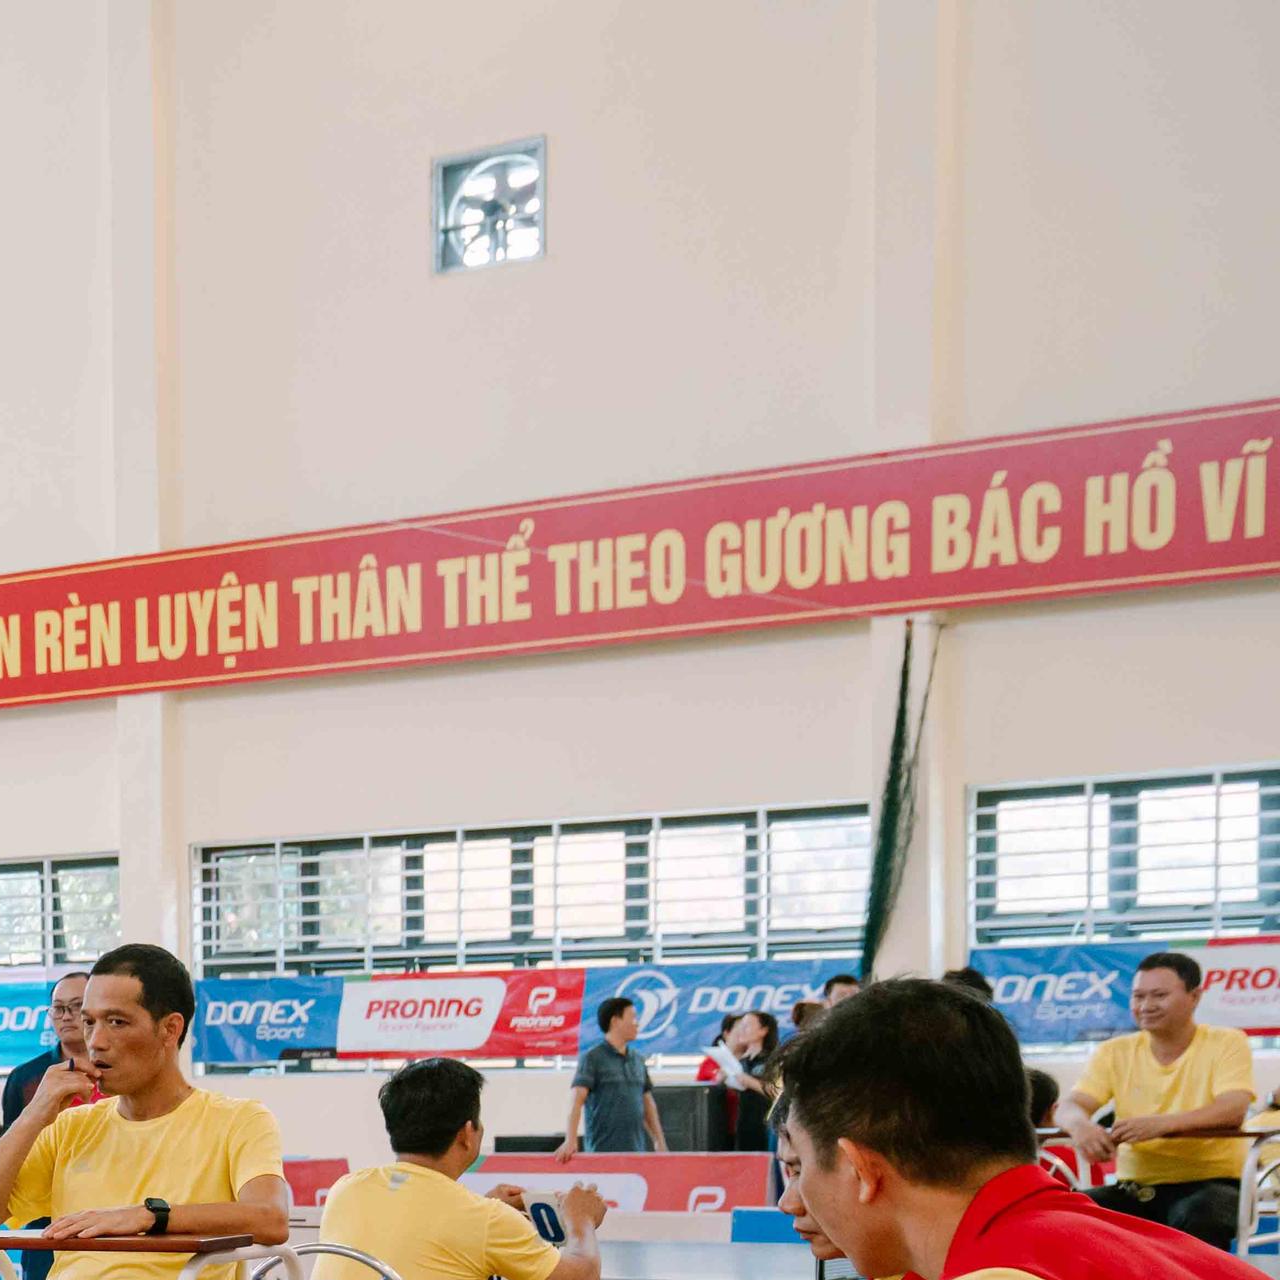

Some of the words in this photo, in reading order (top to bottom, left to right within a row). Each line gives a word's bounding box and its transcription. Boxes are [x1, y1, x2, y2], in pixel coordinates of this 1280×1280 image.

[34, 593, 121, 675] RÈN
[134, 571, 279, 669] LUYỆN
[292, 553, 422, 645] THÂN
[436, 518, 533, 629] THỂ
[547, 528, 687, 616] THEO
[704, 500, 911, 599] GƯƠNG
[931, 470, 1063, 574] BÁC
[1083, 438, 1177, 557] HỒ
[1199, 436, 1274, 543] VĨ
[986, 969, 1120, 1005] ONEX
[205, 998, 316, 1026] DONEX
[365, 996, 485, 1020] PRONING
[1036, 1001, 1107, 1021] Sport
[255, 1024, 306, 1041] Sport
